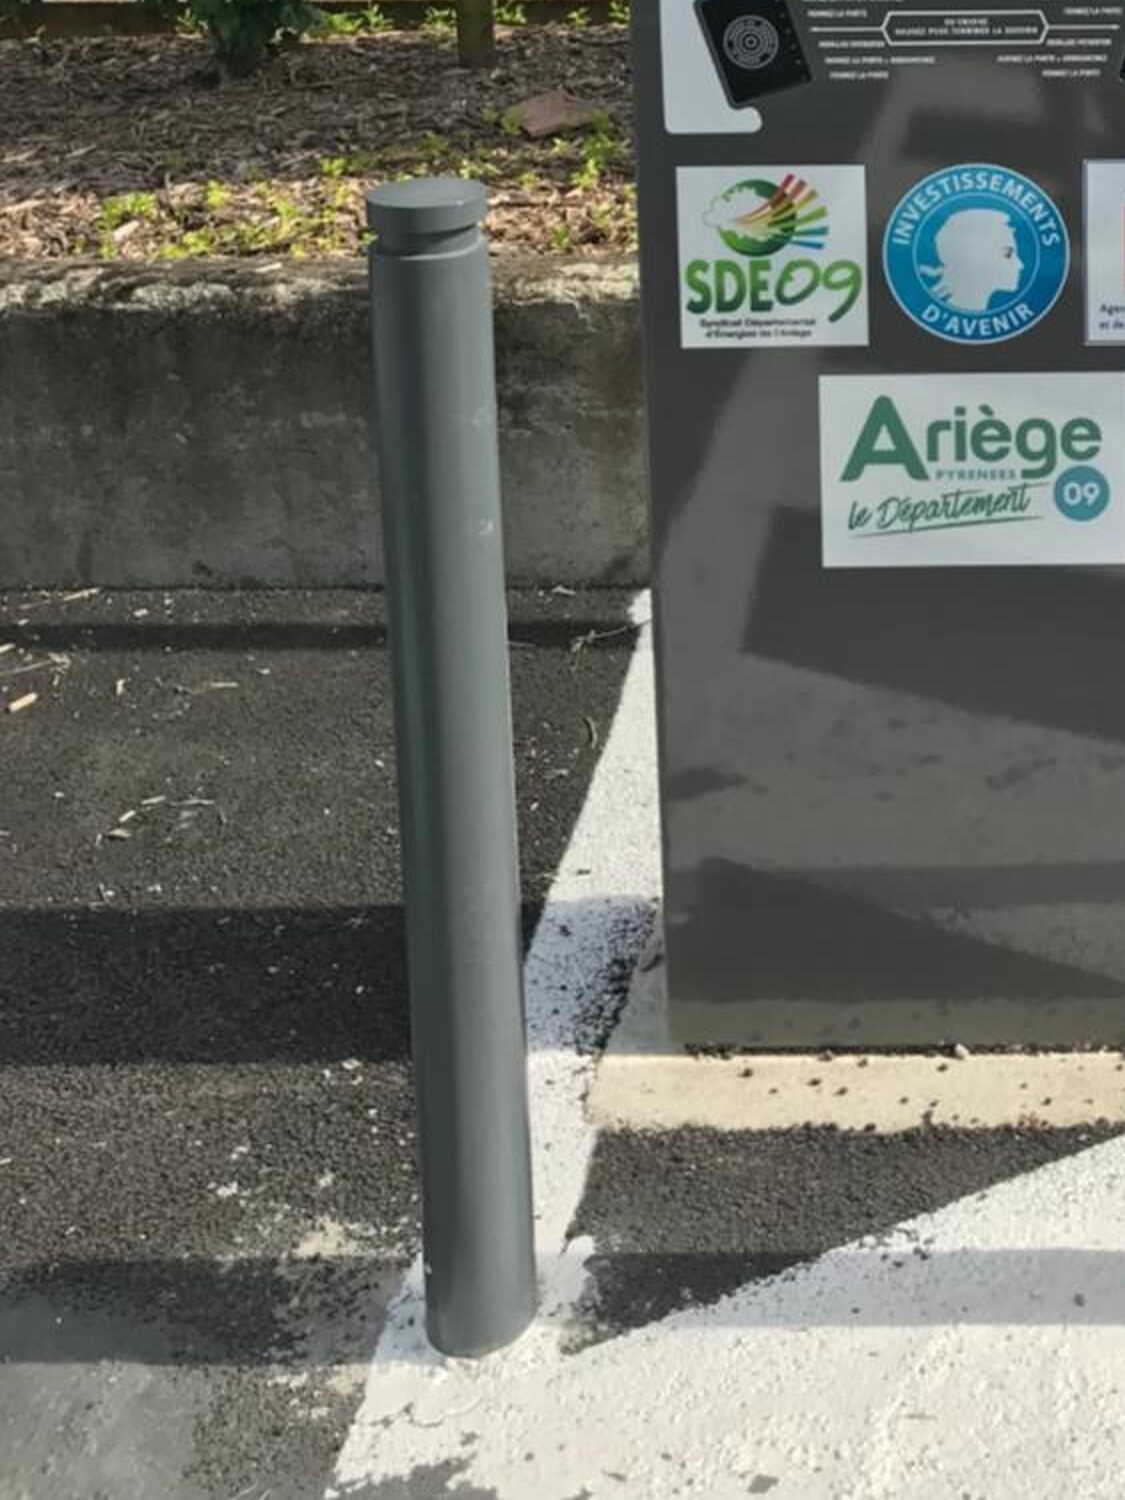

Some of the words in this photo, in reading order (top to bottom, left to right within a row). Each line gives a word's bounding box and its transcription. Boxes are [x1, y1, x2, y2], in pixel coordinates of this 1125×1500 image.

[893, 173, 1061, 248] INVESTISSEMENTS
[685, 259, 863, 323] SDE09
[921, 301, 1036, 337] D'AVENIR
[840, 394, 1102, 481] Ariège
[848, 499, 872, 531] le
[877, 483, 1035, 533] Département
[1063, 481, 1101, 506] 09
